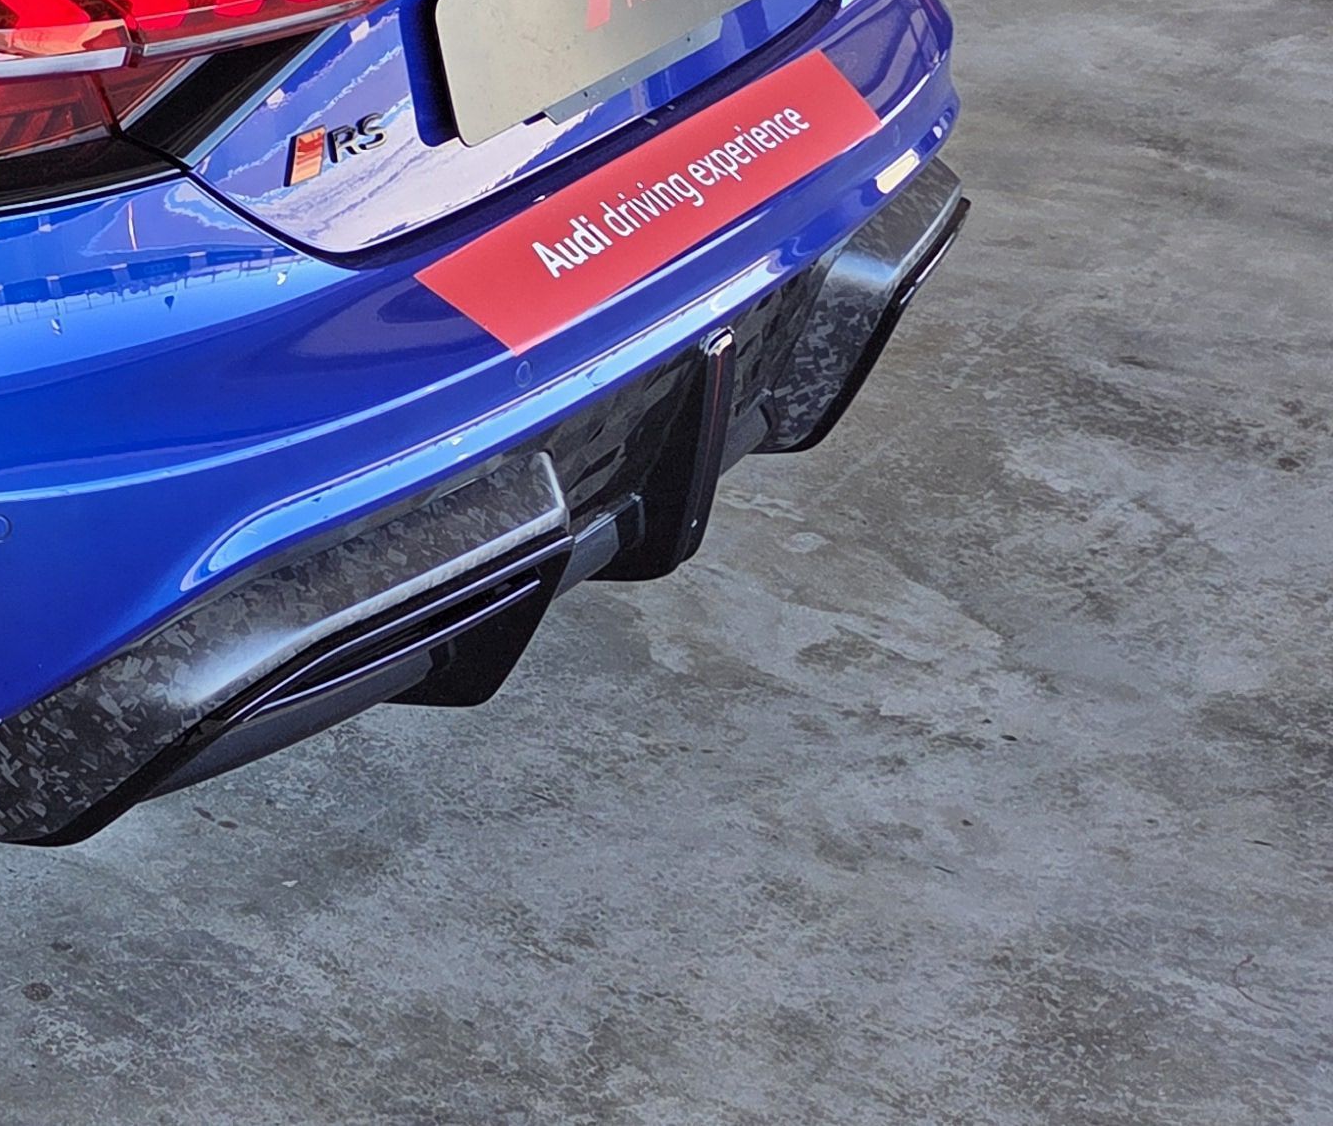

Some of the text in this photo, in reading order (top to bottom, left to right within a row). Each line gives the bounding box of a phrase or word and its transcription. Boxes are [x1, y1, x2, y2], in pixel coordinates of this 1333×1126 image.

[327, 111, 388, 164] RS
[531, 104, 811, 280] Audi driving experience
